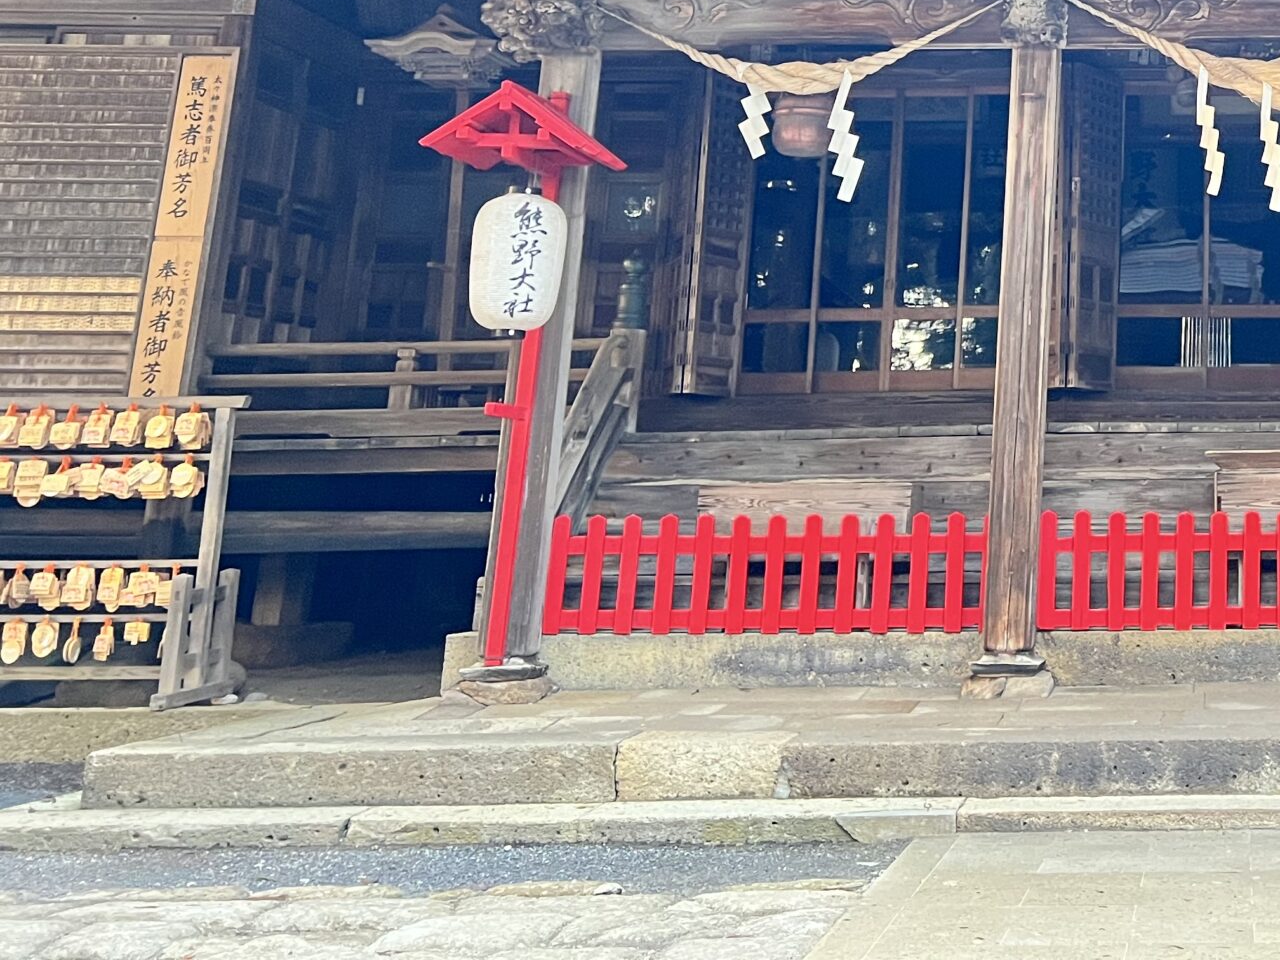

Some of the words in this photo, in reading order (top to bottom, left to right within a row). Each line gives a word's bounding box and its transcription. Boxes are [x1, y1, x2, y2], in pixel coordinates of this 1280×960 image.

[166, 76, 208, 218] 篤志者御芳名
[503, 202, 548, 319] 熊野大社
